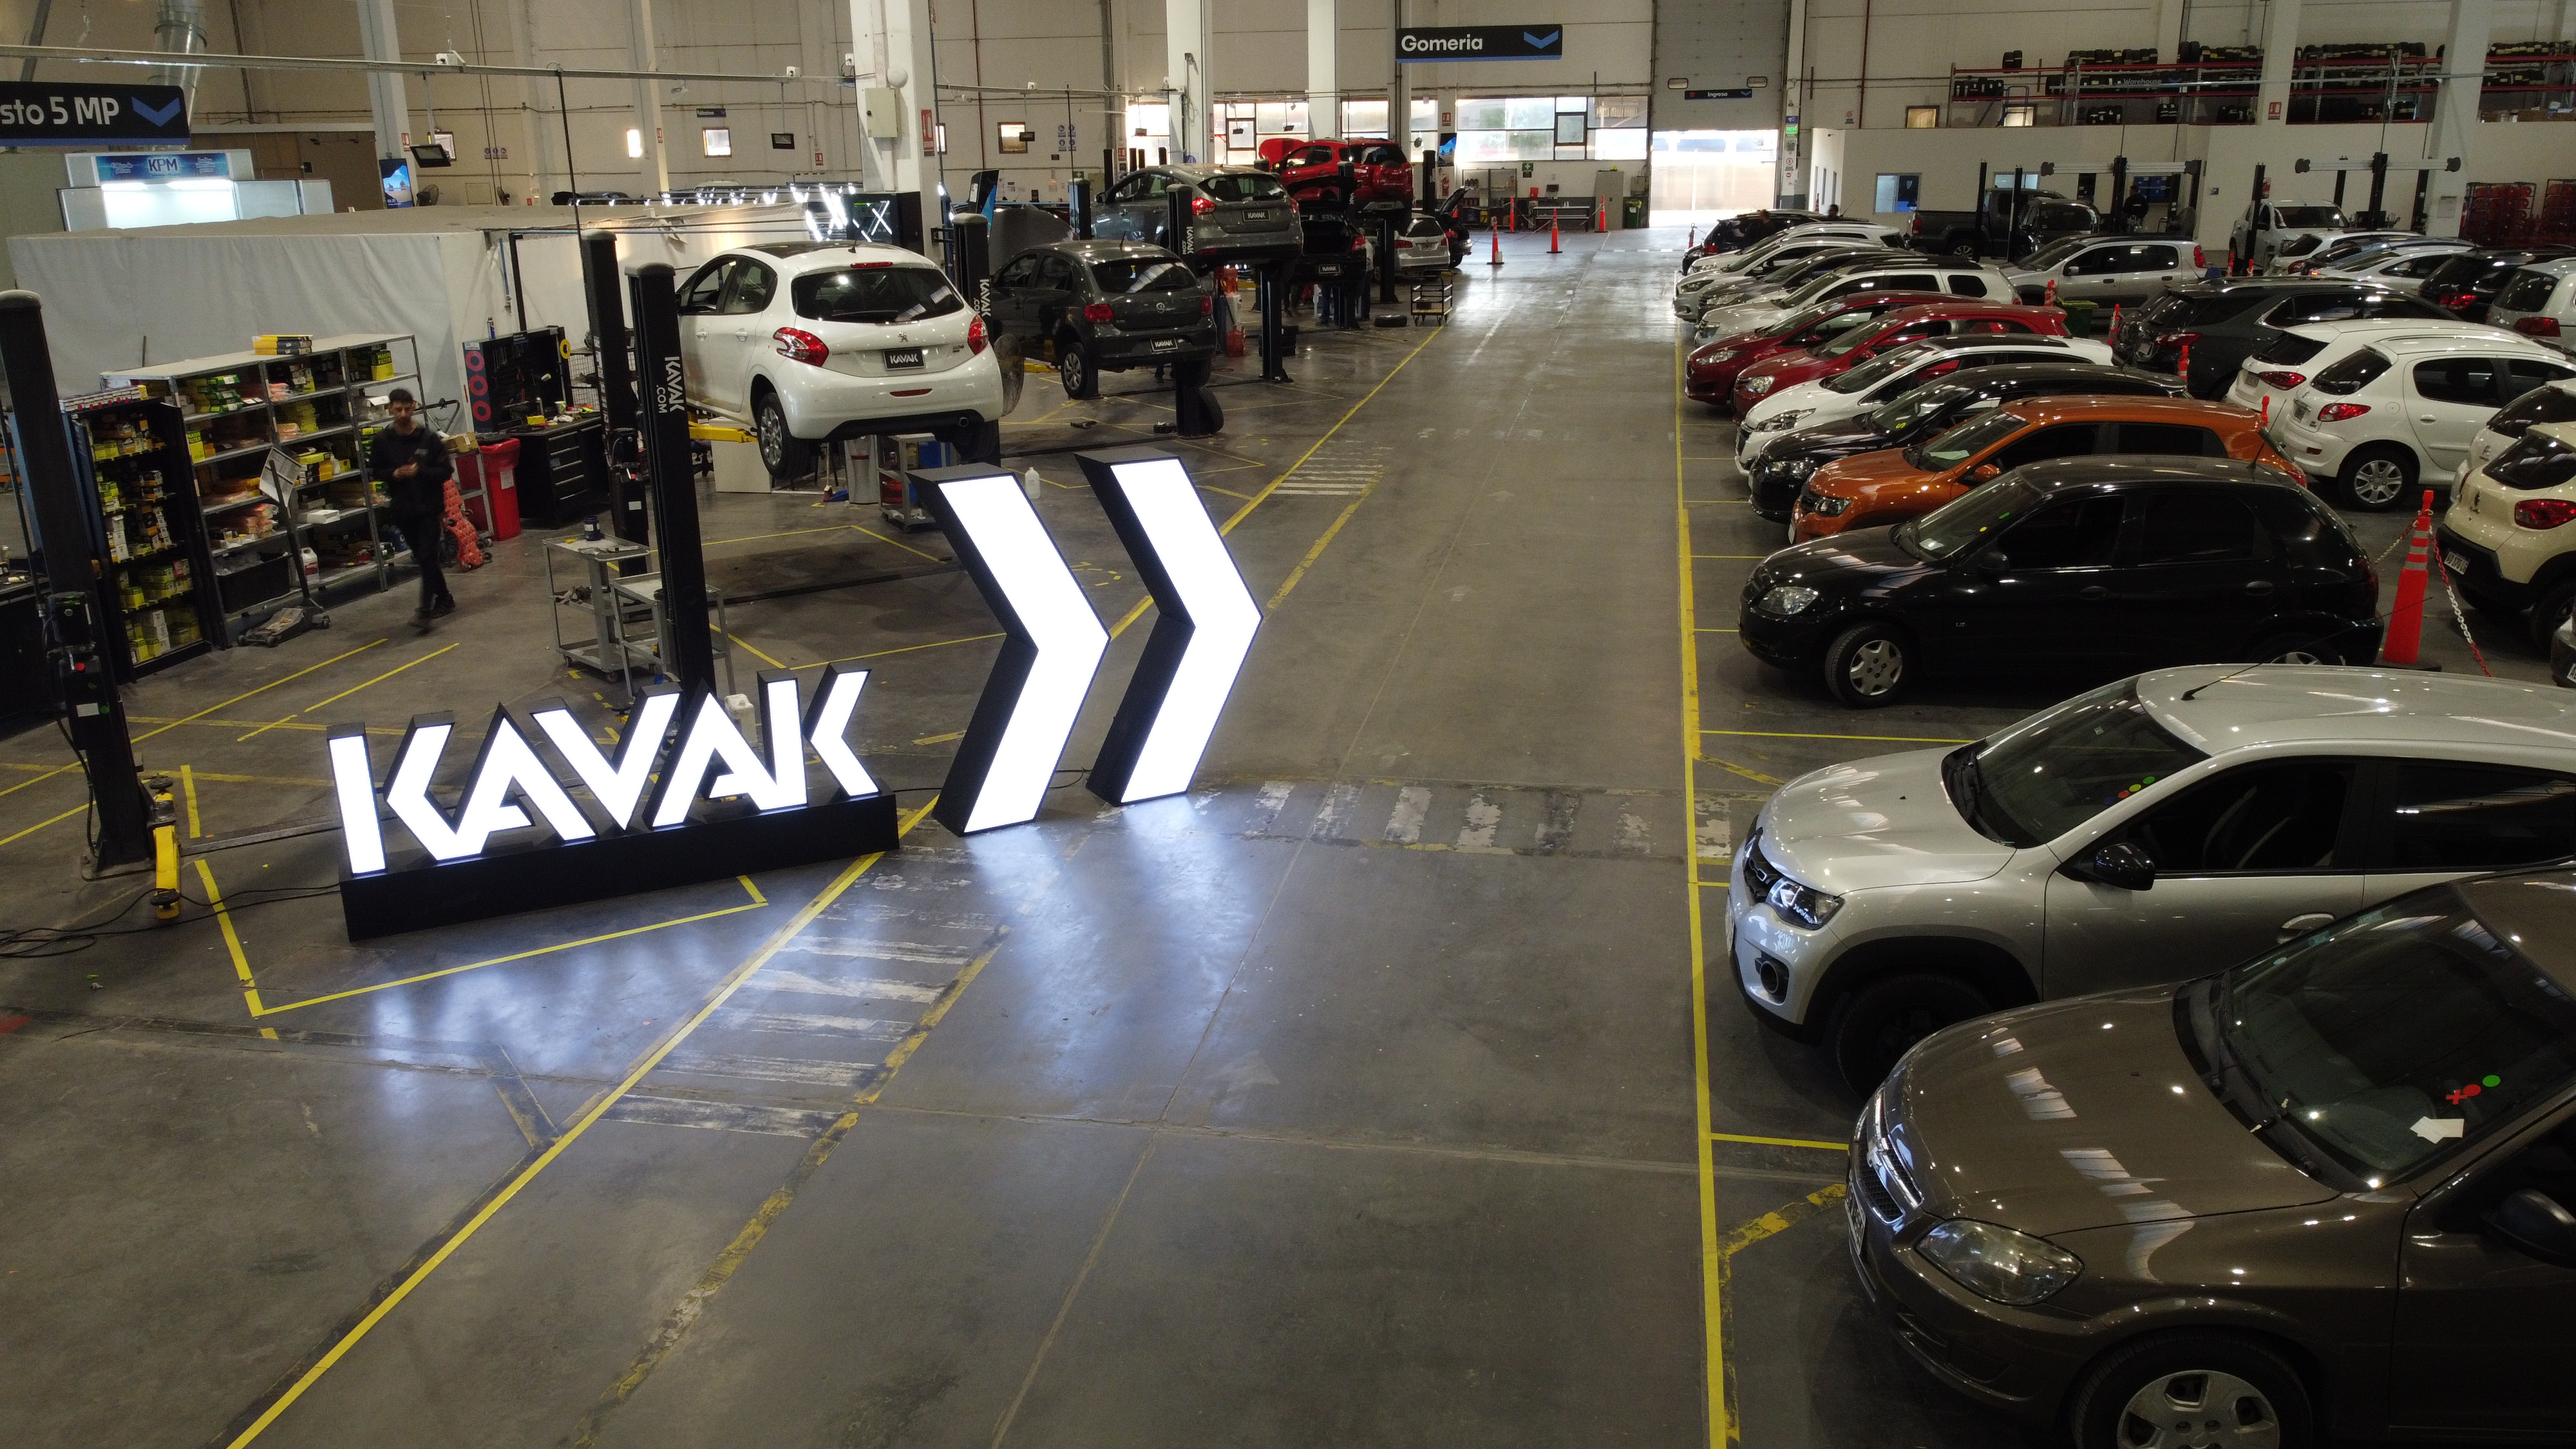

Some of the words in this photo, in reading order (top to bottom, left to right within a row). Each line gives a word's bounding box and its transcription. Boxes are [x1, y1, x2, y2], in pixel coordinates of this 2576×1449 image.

[1401, 33, 1482, 52] Gomeria
[50, 97, 68, 124] 5
[74, 97, 119, 125] MP
[148, 158, 178, 173] KPM
[980, 279, 992, 317] KAVAK
[1155, 339, 1173, 348] KAVAK
[889, 354, 919, 364] KAVAK
[665, 356, 685, 412] KAVAK
[656, 384, 668, 413] .COM
[328, 668, 880, 875] KAVAK
